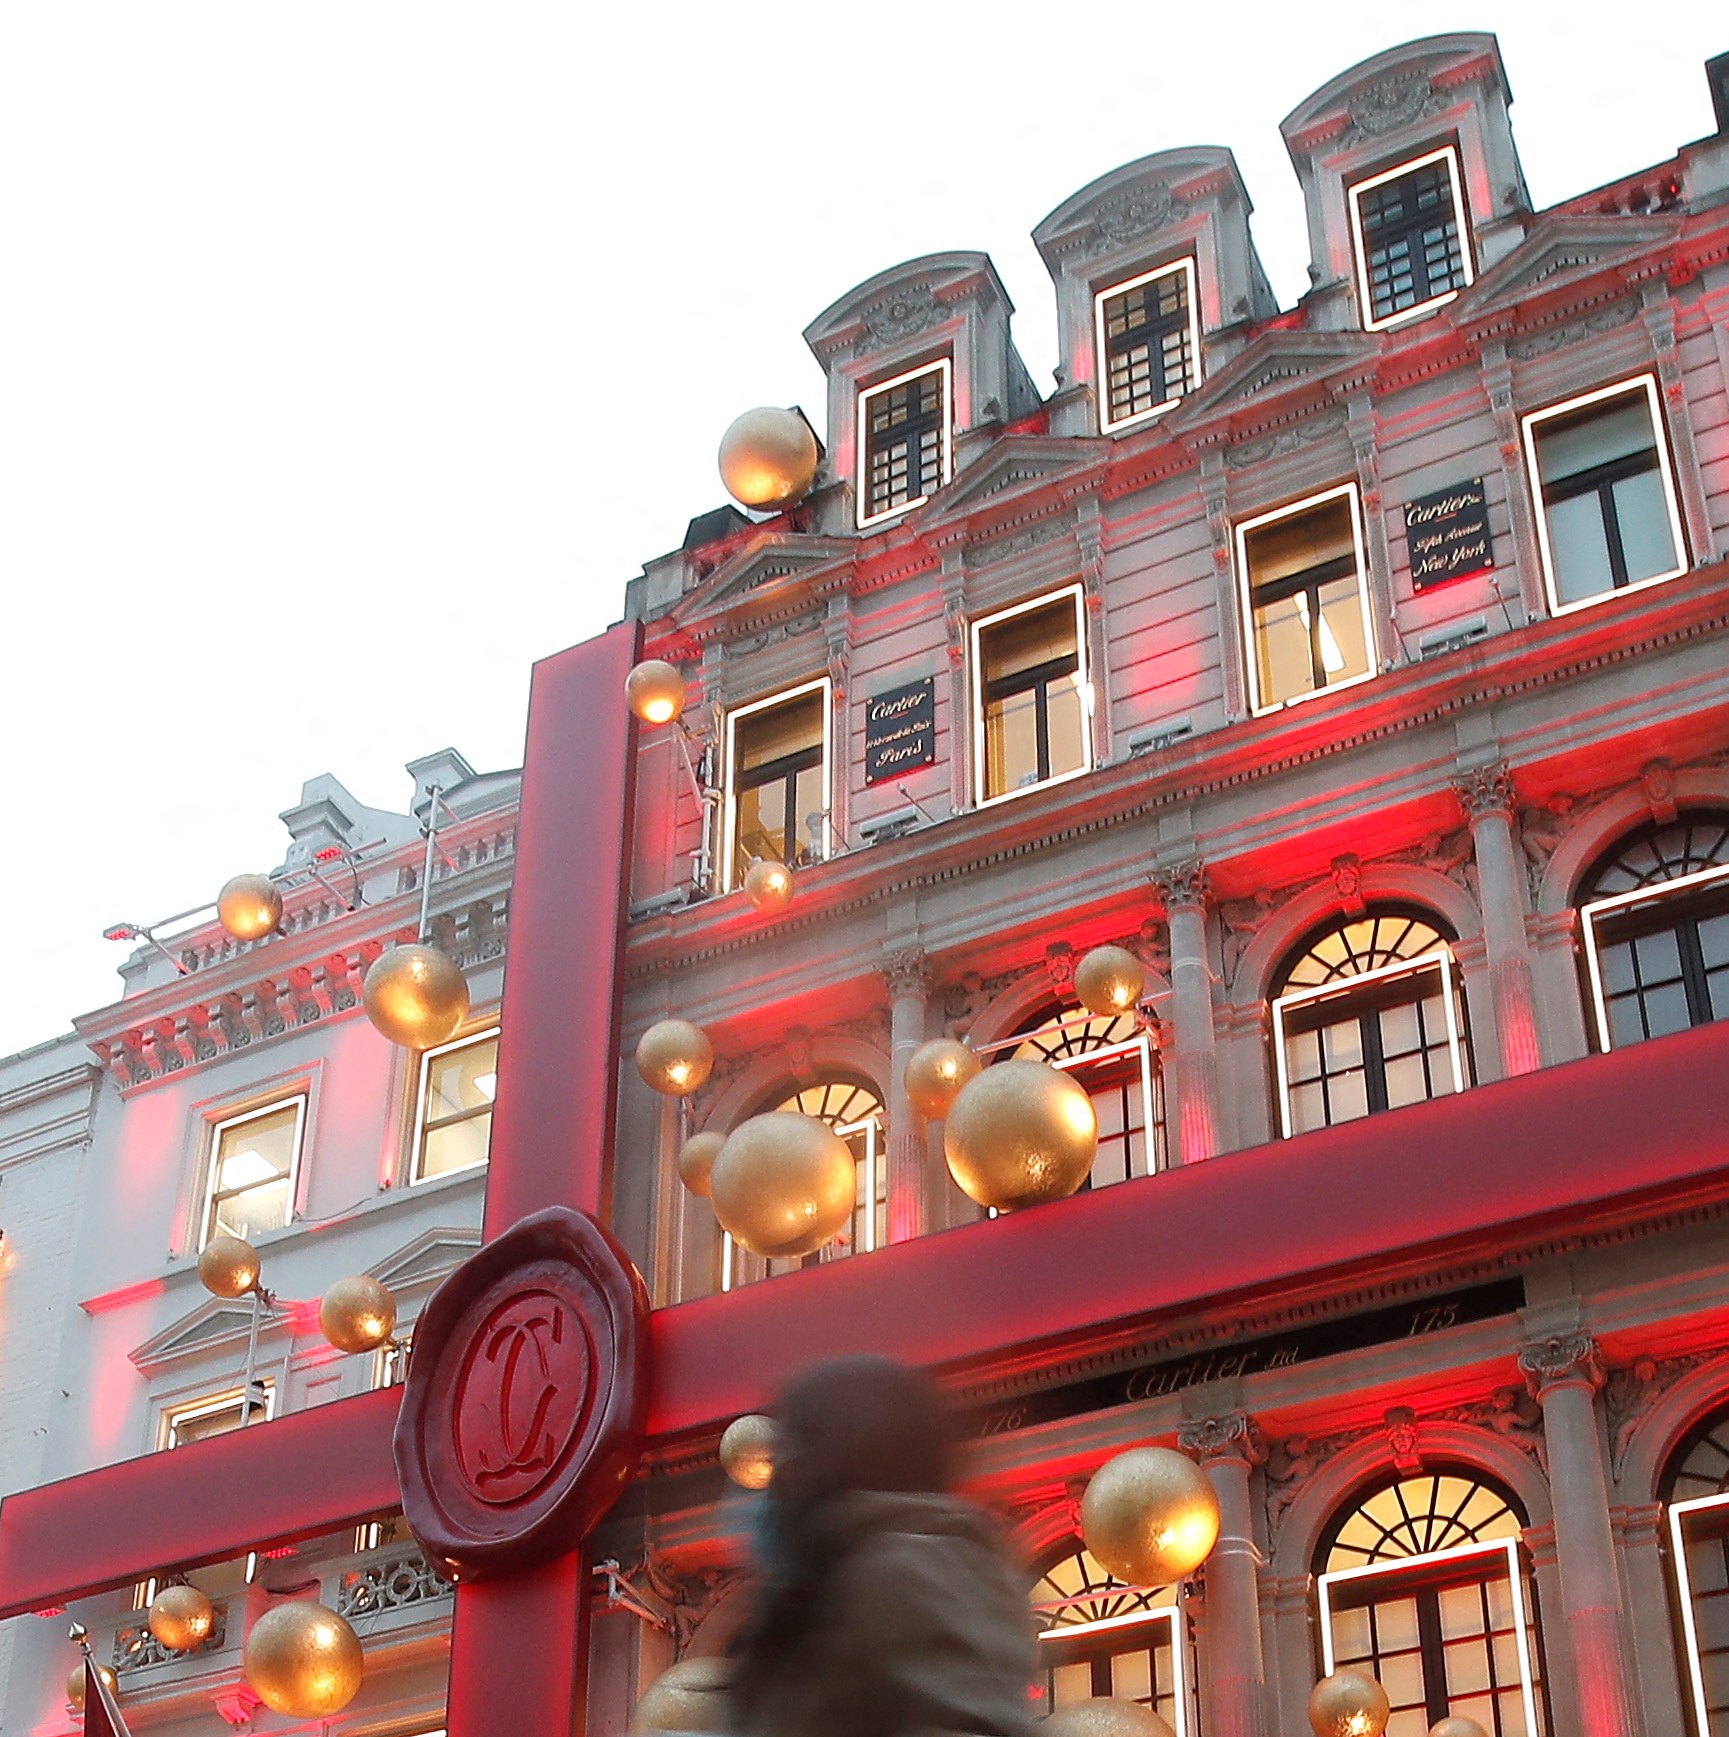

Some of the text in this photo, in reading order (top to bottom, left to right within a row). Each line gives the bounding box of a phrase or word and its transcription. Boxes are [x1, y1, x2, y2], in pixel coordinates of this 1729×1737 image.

[1406, 496, 1469, 527] Cartier
[1413, 539, 1486, 577] New York
[871, 692, 927, 721] Cartier
[1408, 1302, 1460, 1336] 175
[1125, 1351, 1258, 1402] Cartier
